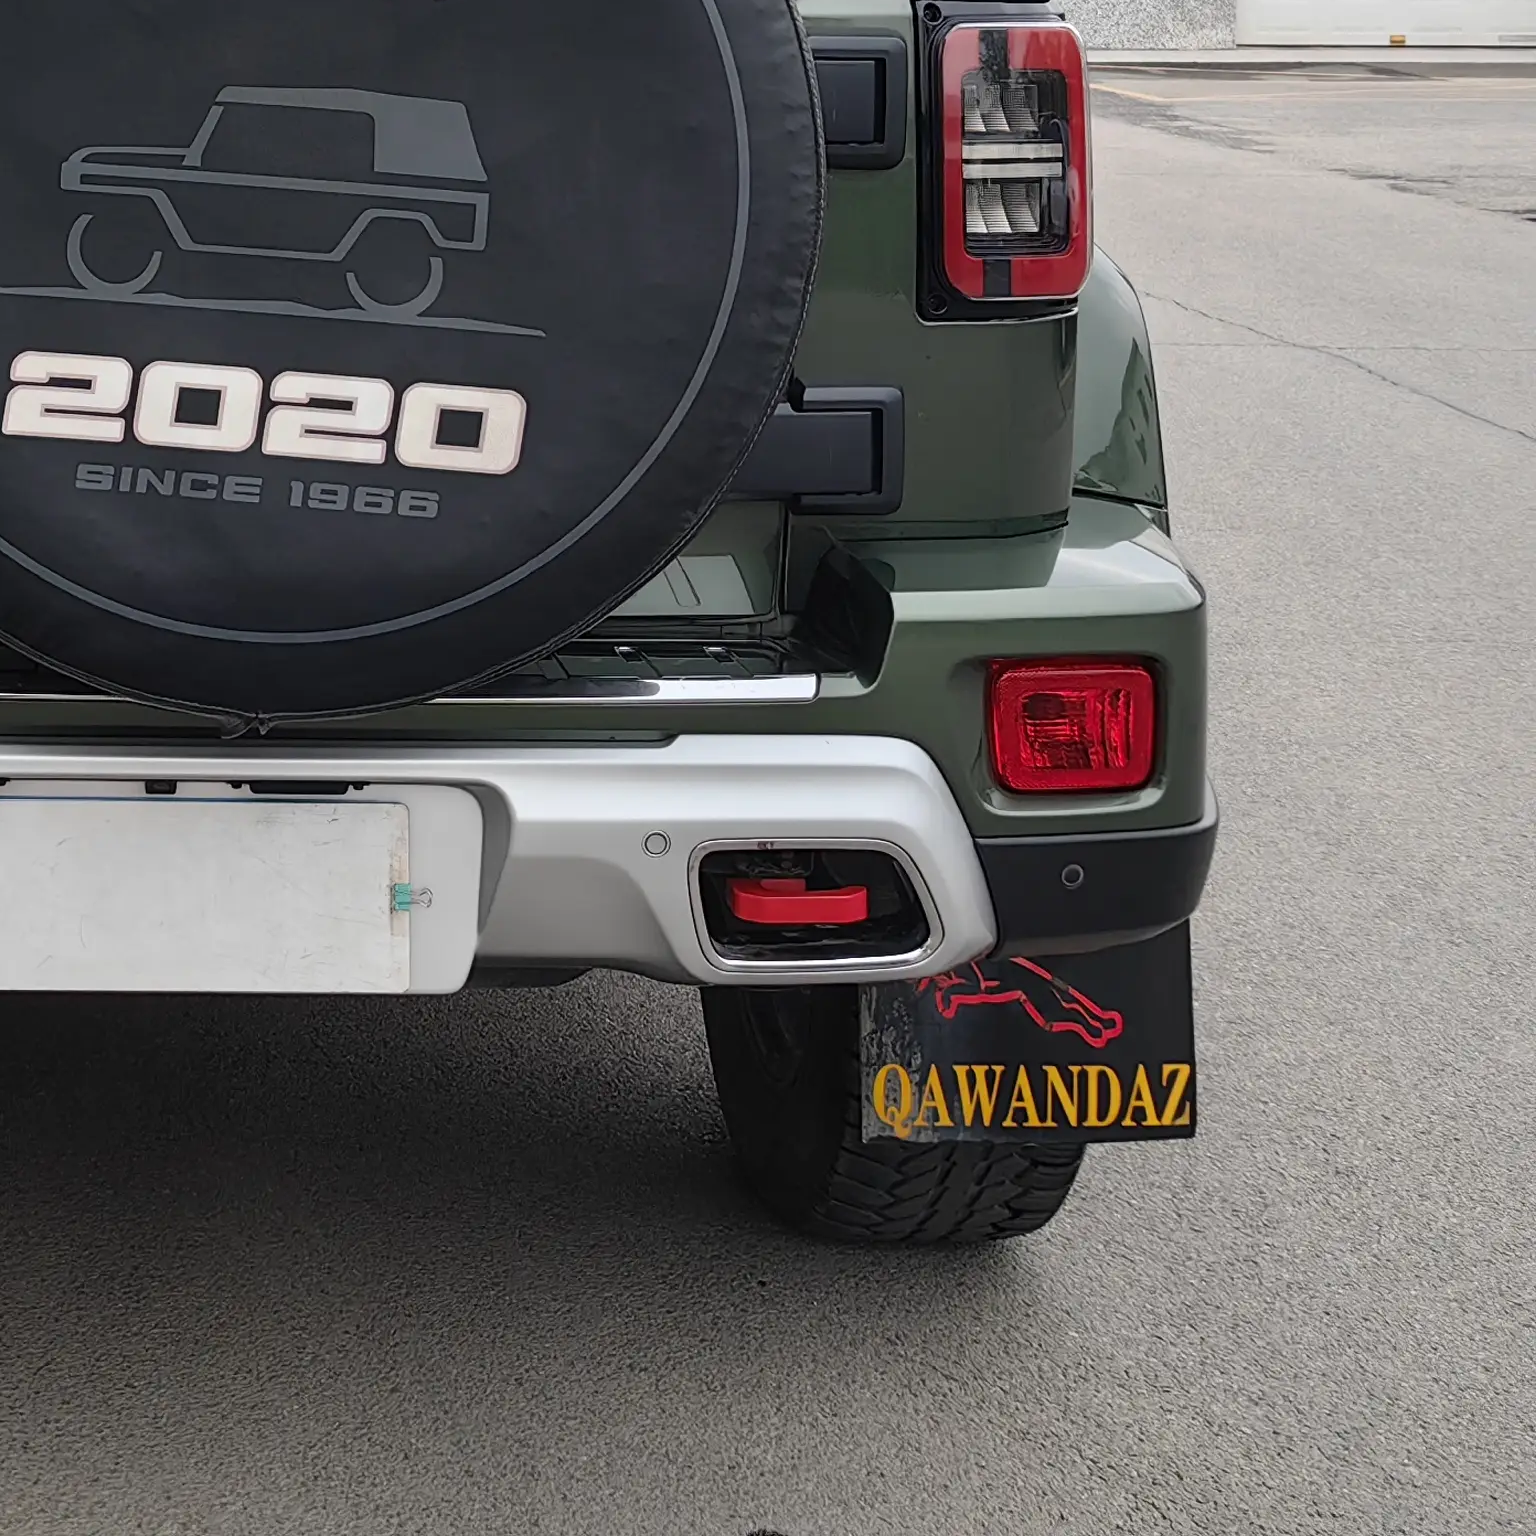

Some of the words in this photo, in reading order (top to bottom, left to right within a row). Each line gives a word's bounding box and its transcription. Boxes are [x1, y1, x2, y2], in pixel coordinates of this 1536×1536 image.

[1, 350, 527, 476] 2020
[75, 463, 263, 504] SINCE
[289, 480, 441, 519] 1966
[872, 1063, 1191, 1138] QAWANDAZ
